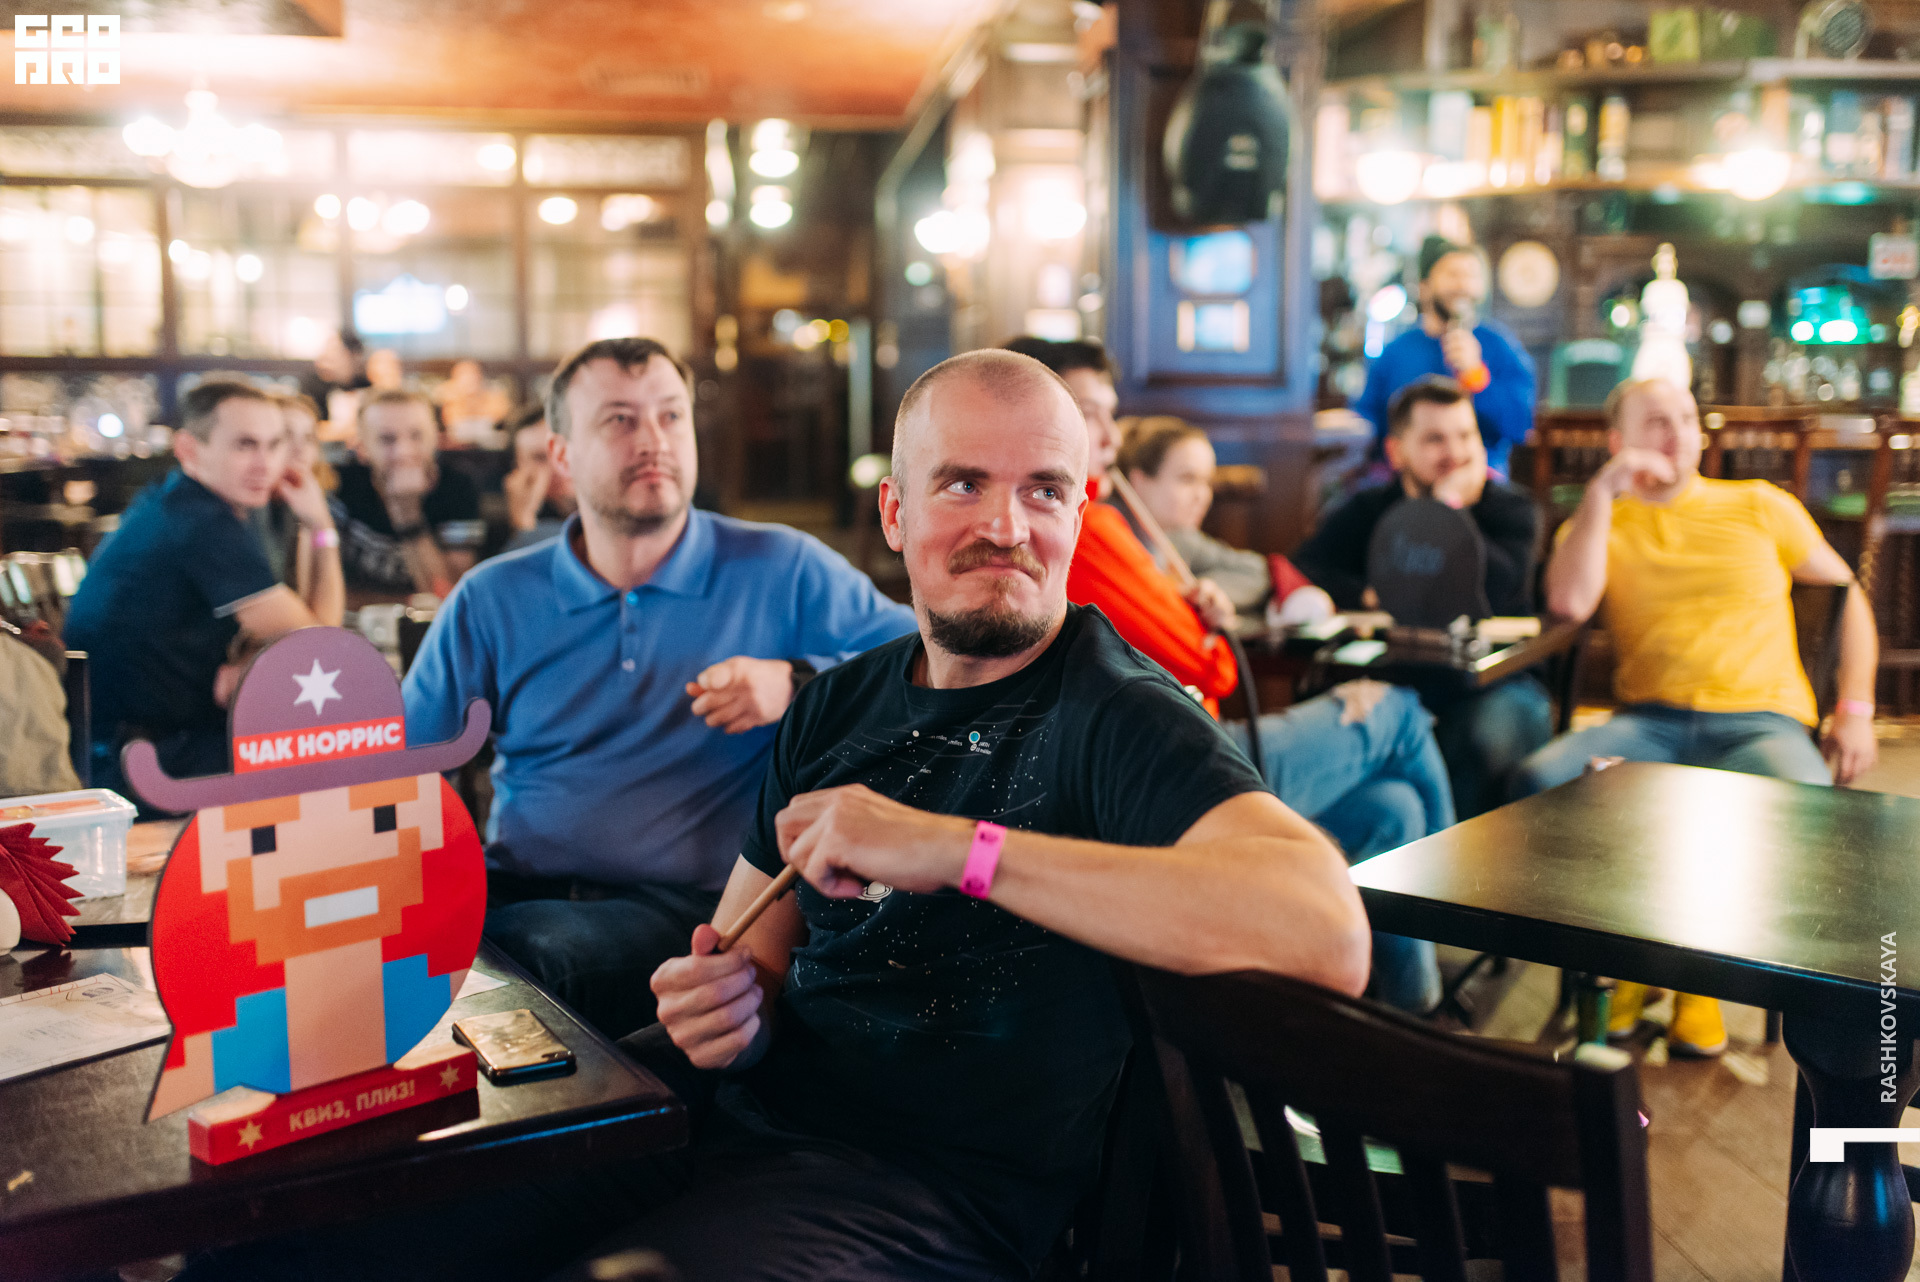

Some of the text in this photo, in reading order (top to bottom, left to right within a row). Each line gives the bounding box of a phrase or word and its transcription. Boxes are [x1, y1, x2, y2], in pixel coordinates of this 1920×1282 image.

[238, 722, 401, 765] ЧАК НОРРИС
[289, 1079, 415, 1132] КВИЗ, ПЛИЗ!
